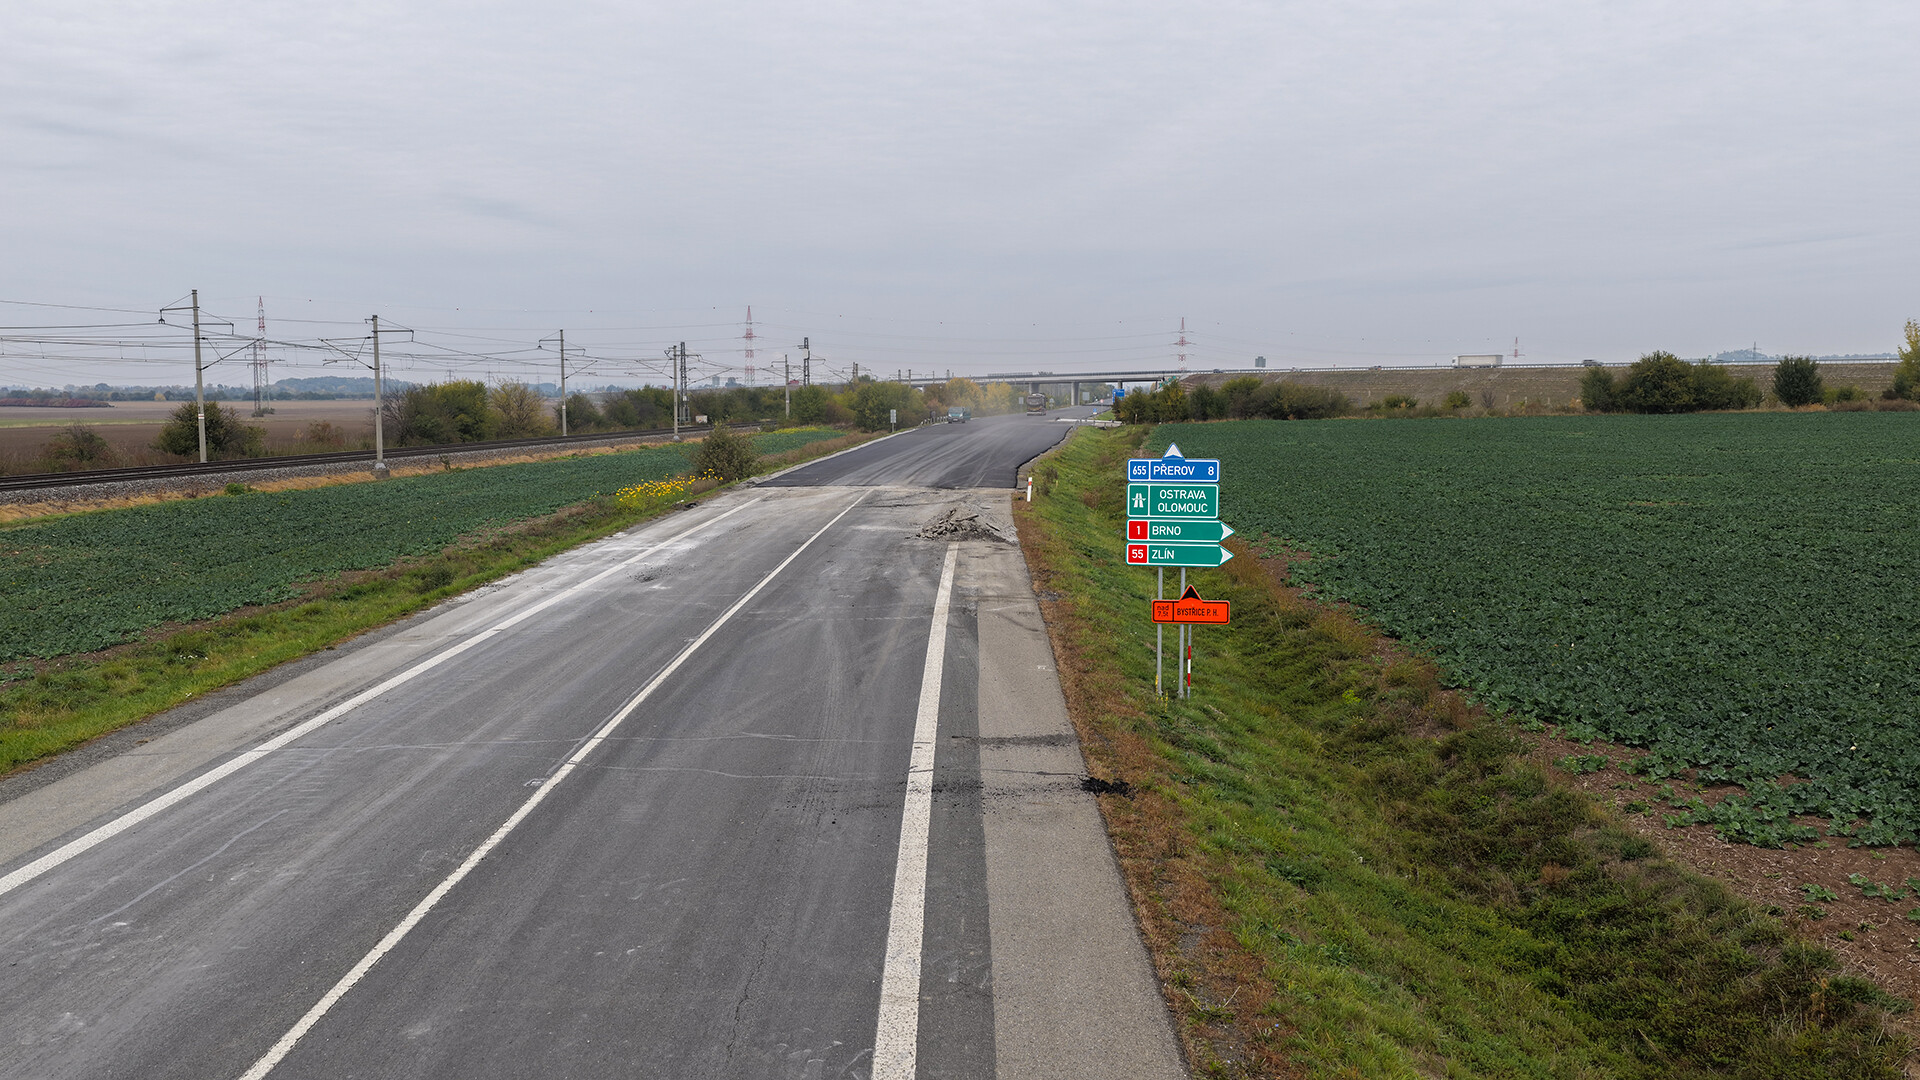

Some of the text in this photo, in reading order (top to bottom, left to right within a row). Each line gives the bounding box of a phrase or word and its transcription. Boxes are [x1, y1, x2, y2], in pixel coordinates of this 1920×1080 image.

[1132, 463, 1214, 476] 655 PŘEROV 8
[1159, 489, 1207, 500] OSTRAVA
[1157, 502, 1208, 513] OLOMOUC
[1136, 525, 1182, 536] 1 BRNO
[1131, 547, 1175, 560] 55 ZLÍN
